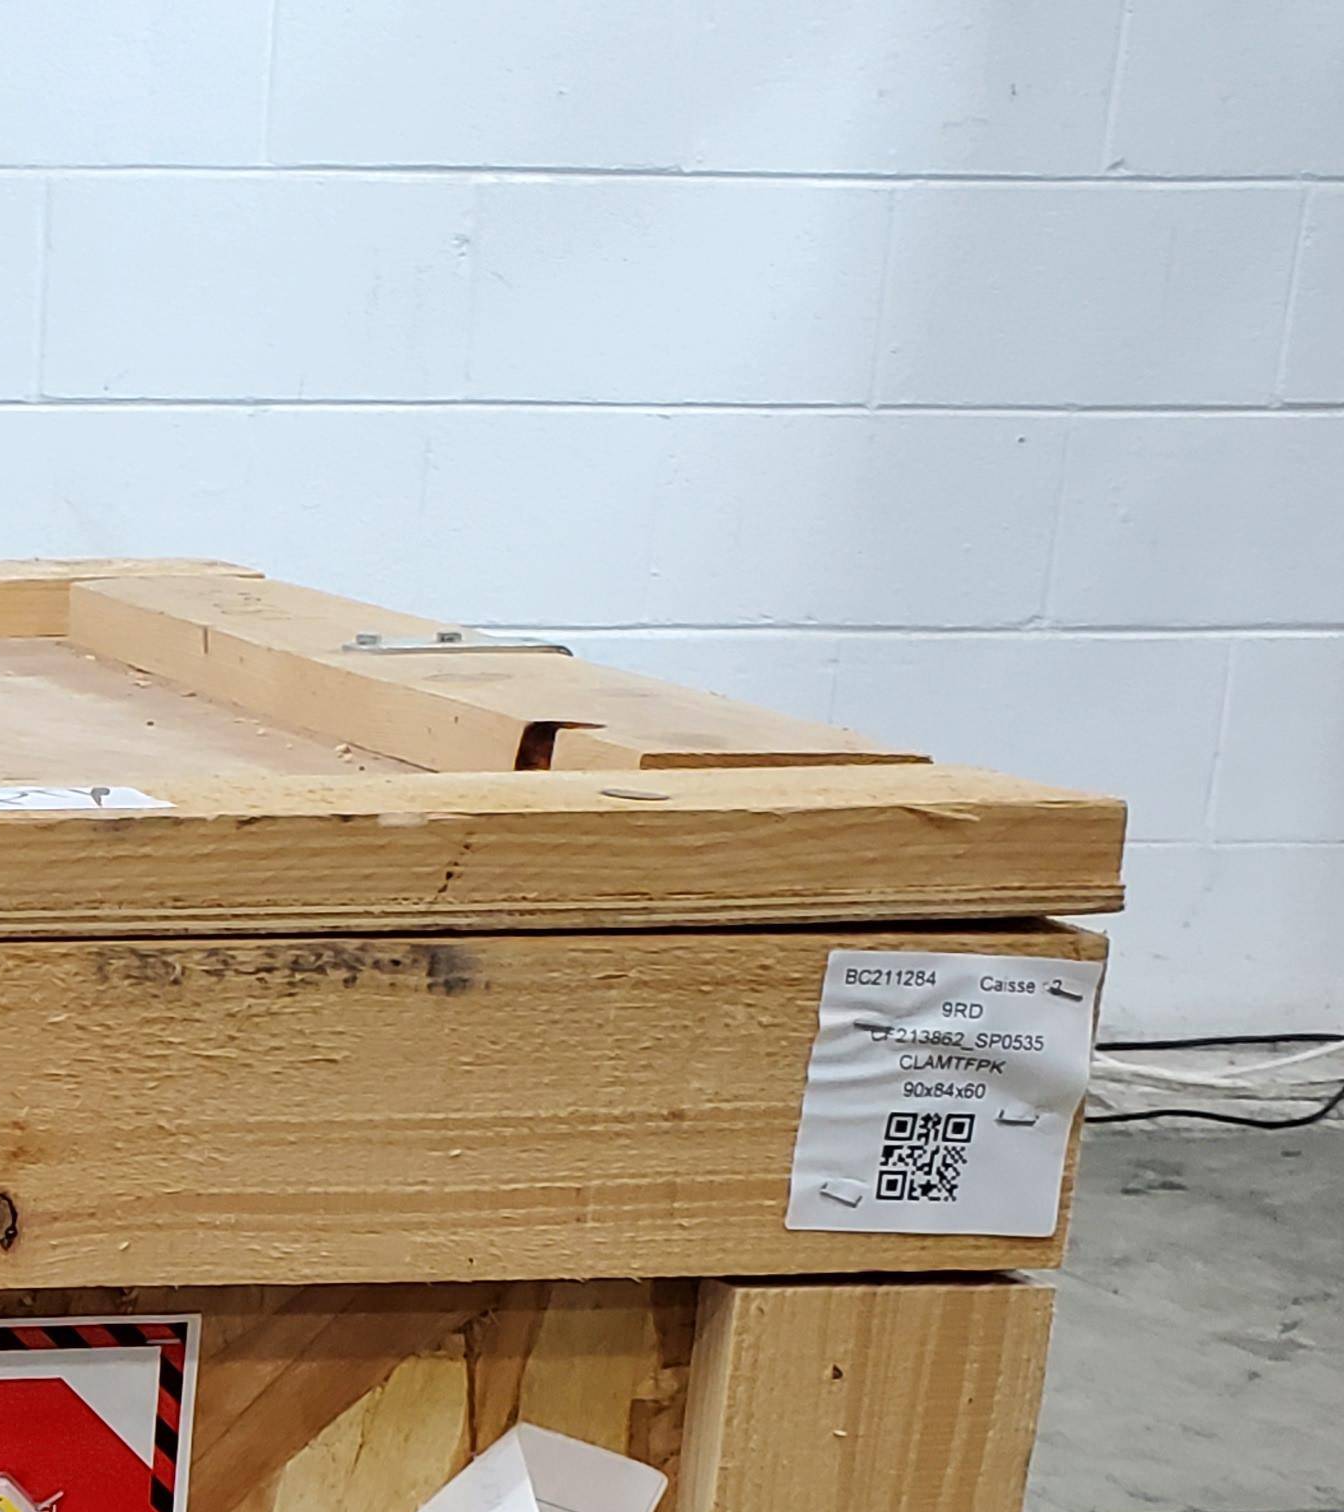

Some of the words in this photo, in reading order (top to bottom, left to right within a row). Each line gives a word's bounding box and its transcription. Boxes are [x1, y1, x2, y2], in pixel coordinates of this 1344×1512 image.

[845, 969, 936, 986] BC211284
[980, 977, 1035, 993] Caisse
[942, 1002, 983, 1019] 9RD
[899, 1055, 1007, 1074] CLAMTFPK
[903, 1082, 986, 1099] 90x84x60
